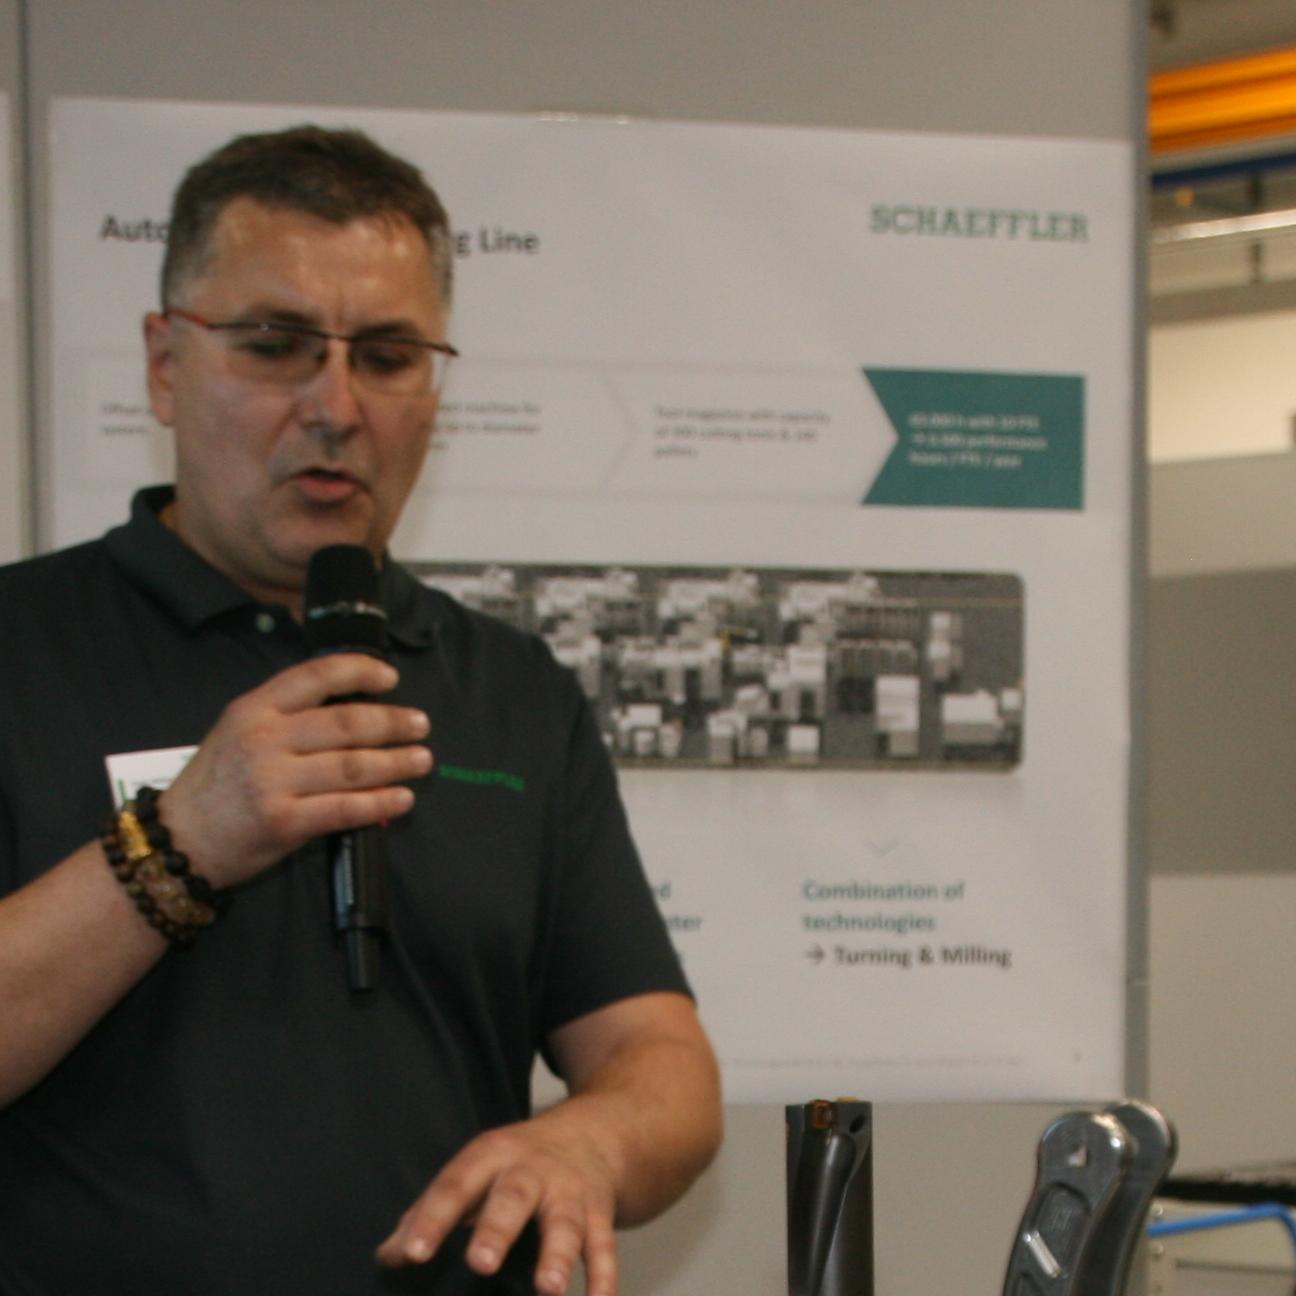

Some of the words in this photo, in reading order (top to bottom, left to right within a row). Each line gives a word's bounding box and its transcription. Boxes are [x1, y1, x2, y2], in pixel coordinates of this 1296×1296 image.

[870, 203, 1089, 242] SCHAEFFLER
[481, 228, 539, 254] Line
[802, 880, 938, 900] Combination
[945, 879, 965, 899] of
[802, 911, 936, 934] technologies
[834, 945, 912, 969] Turning
[919, 946, 934, 965] &
[942, 946, 1013, 969] Milling
